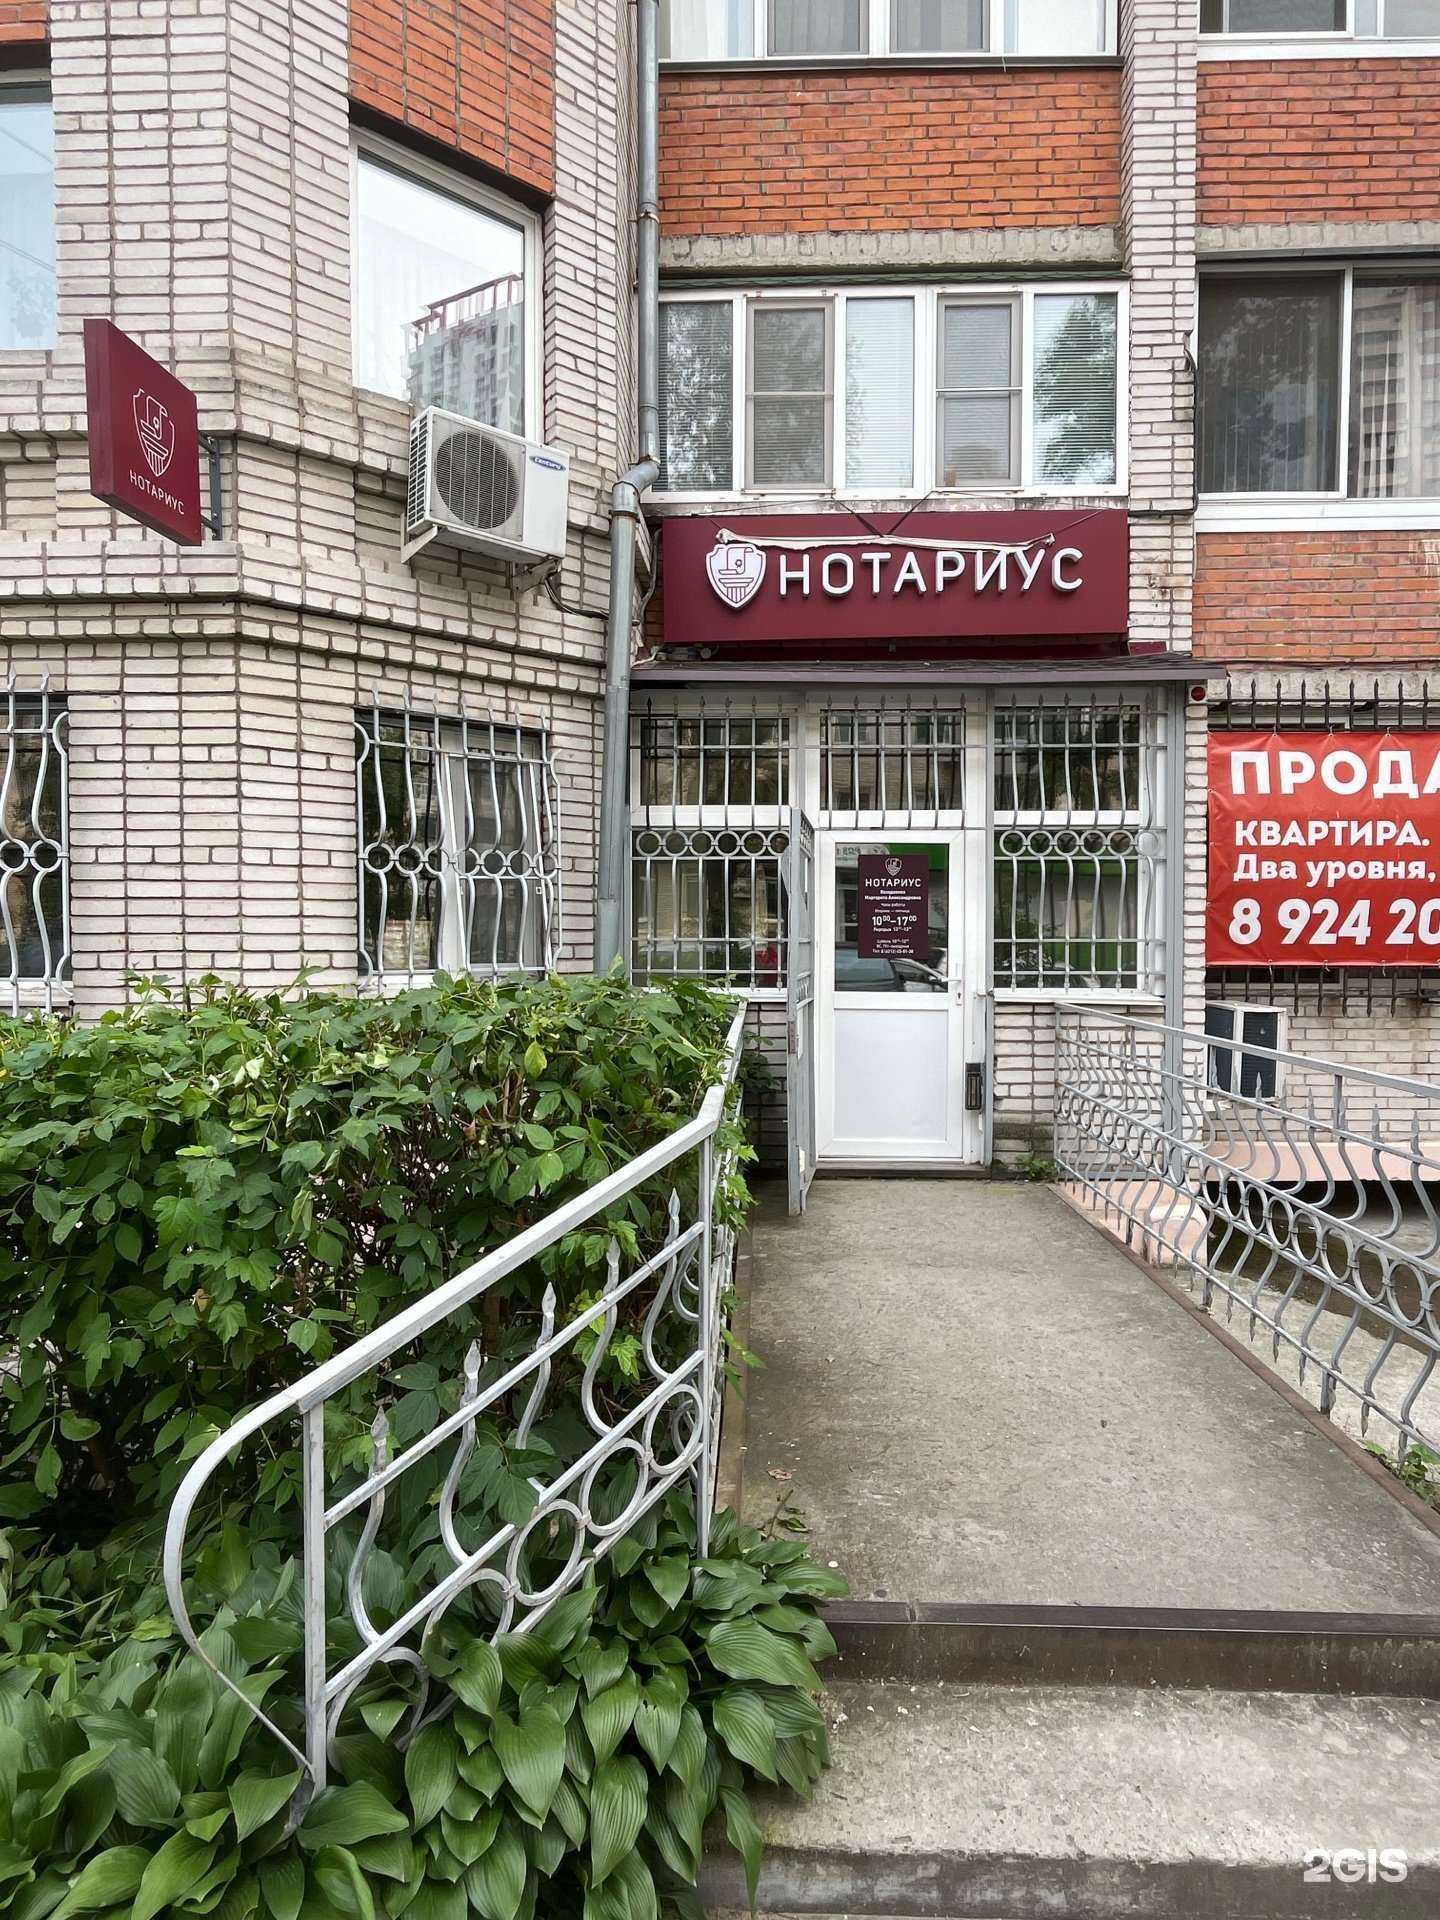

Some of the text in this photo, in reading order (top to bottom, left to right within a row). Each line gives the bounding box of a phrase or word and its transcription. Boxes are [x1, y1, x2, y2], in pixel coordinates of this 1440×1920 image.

[129, 470, 185, 515] НОТАРИУС
[780, 547, 1084, 597] НОТАРИУС
[1234, 820, 1431, 847] КВАРТИРА.
[865, 878, 922, 888] НОТАРИУС
[1233, 853, 1437, 888] Два уровня,
[1228, 898, 1262, 945] 8
[1278, 898, 1372, 945] 924
